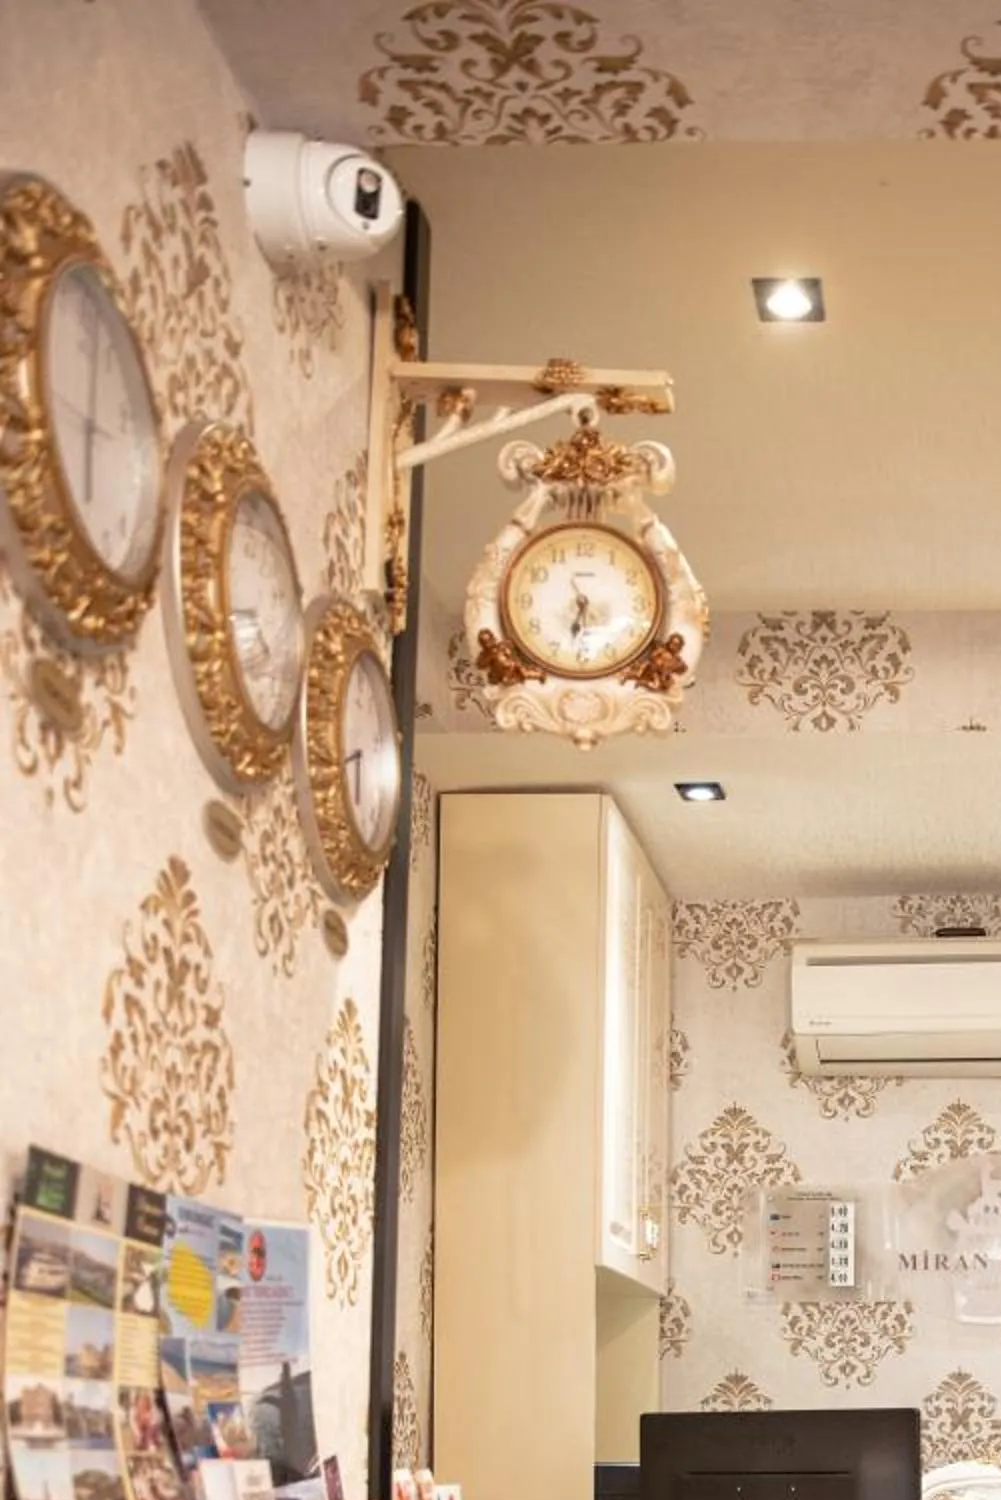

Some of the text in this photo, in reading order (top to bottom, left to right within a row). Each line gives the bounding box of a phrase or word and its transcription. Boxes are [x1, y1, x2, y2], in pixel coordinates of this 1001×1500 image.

[551, 549, 566, 563] 11
[576, 542, 594, 557] 12
[530, 567, 549, 583] 10
